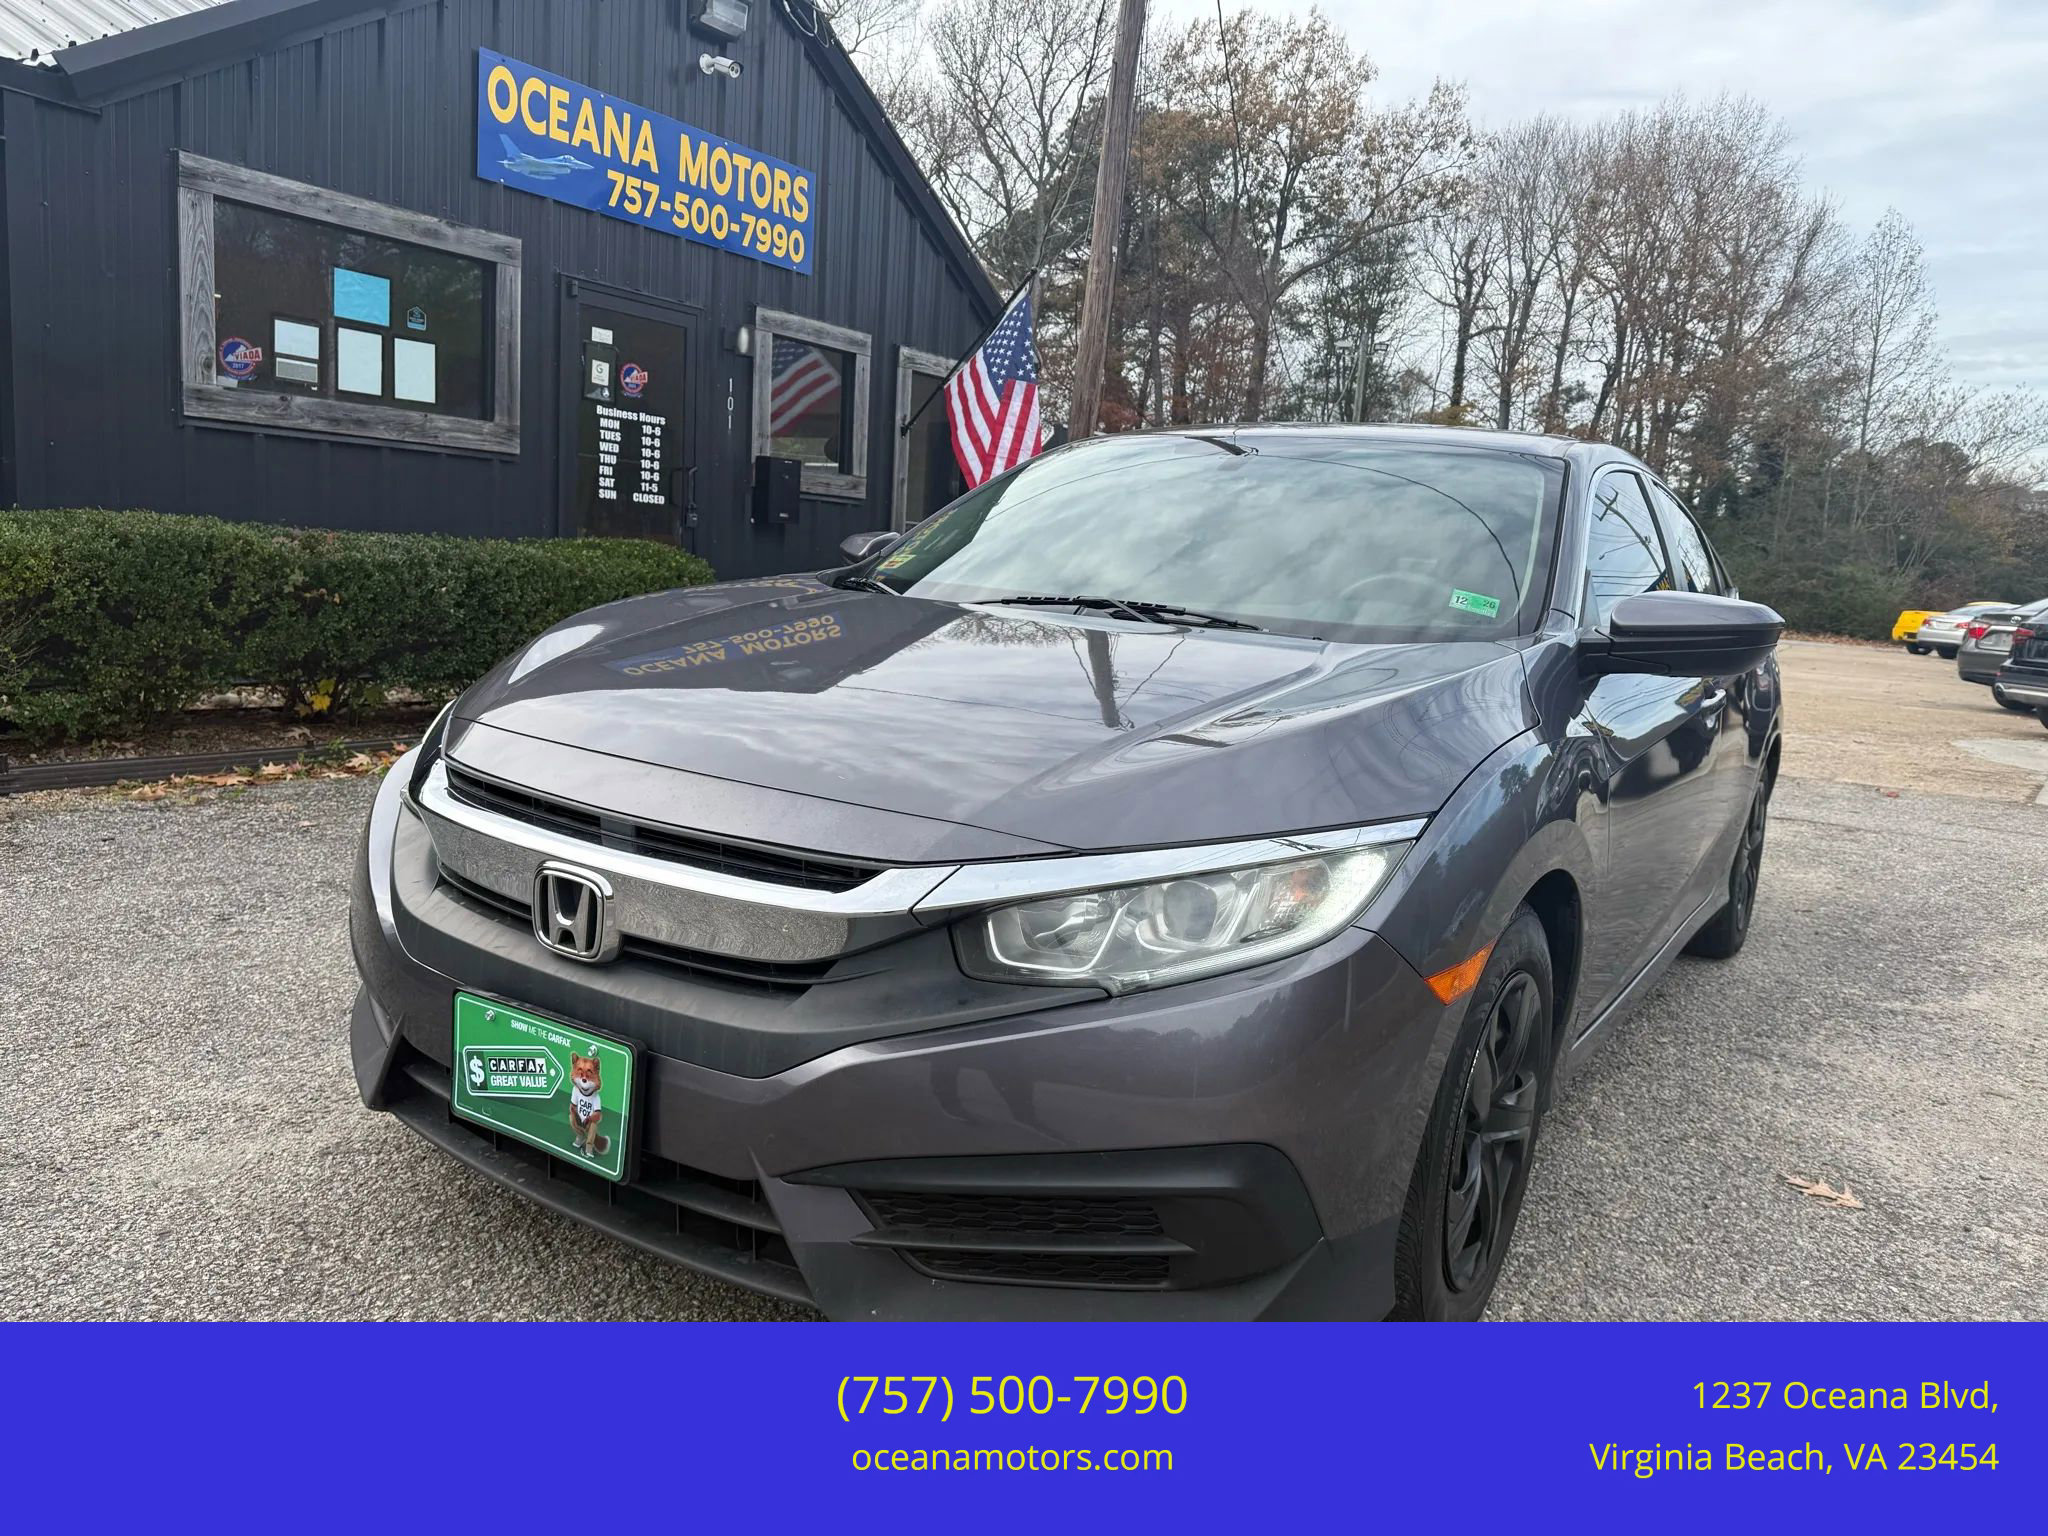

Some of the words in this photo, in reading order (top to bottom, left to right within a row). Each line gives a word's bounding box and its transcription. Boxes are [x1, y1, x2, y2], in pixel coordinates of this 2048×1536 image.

[487, 65, 659, 174] OCEANA
[678, 133, 809, 223] MOTORS
[607, 169, 805, 263] 757-500-7990
[596, 404, 638, 421] Business
[639, 412, 666, 425] Hours
[600, 417, 620, 430] MON
[641, 424, 661, 436] 10-6
[599, 429, 621, 442] TUES
[641, 436, 660, 448] 10-6
[599, 441, 619, 453] WED
[641, 448, 660, 459] 10-6
[599, 453, 617, 465] THU
[640, 459, 660, 470] 10-6
[599, 465, 613, 476] FRI
[640, 470, 660, 482] 10-6
[598, 476, 615, 488] SAT
[640, 482, 658, 493] 11-5
[598, 488, 617, 500] SUN
[632, 492, 665, 505] CLOSED
[511, 1019, 528, 1032] SHOW
[529, 1026, 536, 1036] ME
[537, 1028, 547, 1039] THE
[548, 1032, 571, 1047] CARFAX
[489, 1058, 545, 1074] CARFAX
[490, 1075, 518, 1087] GREAT
[520, 1076, 548, 1088] VALUE
[579, 1099, 592, 1110] CAR
